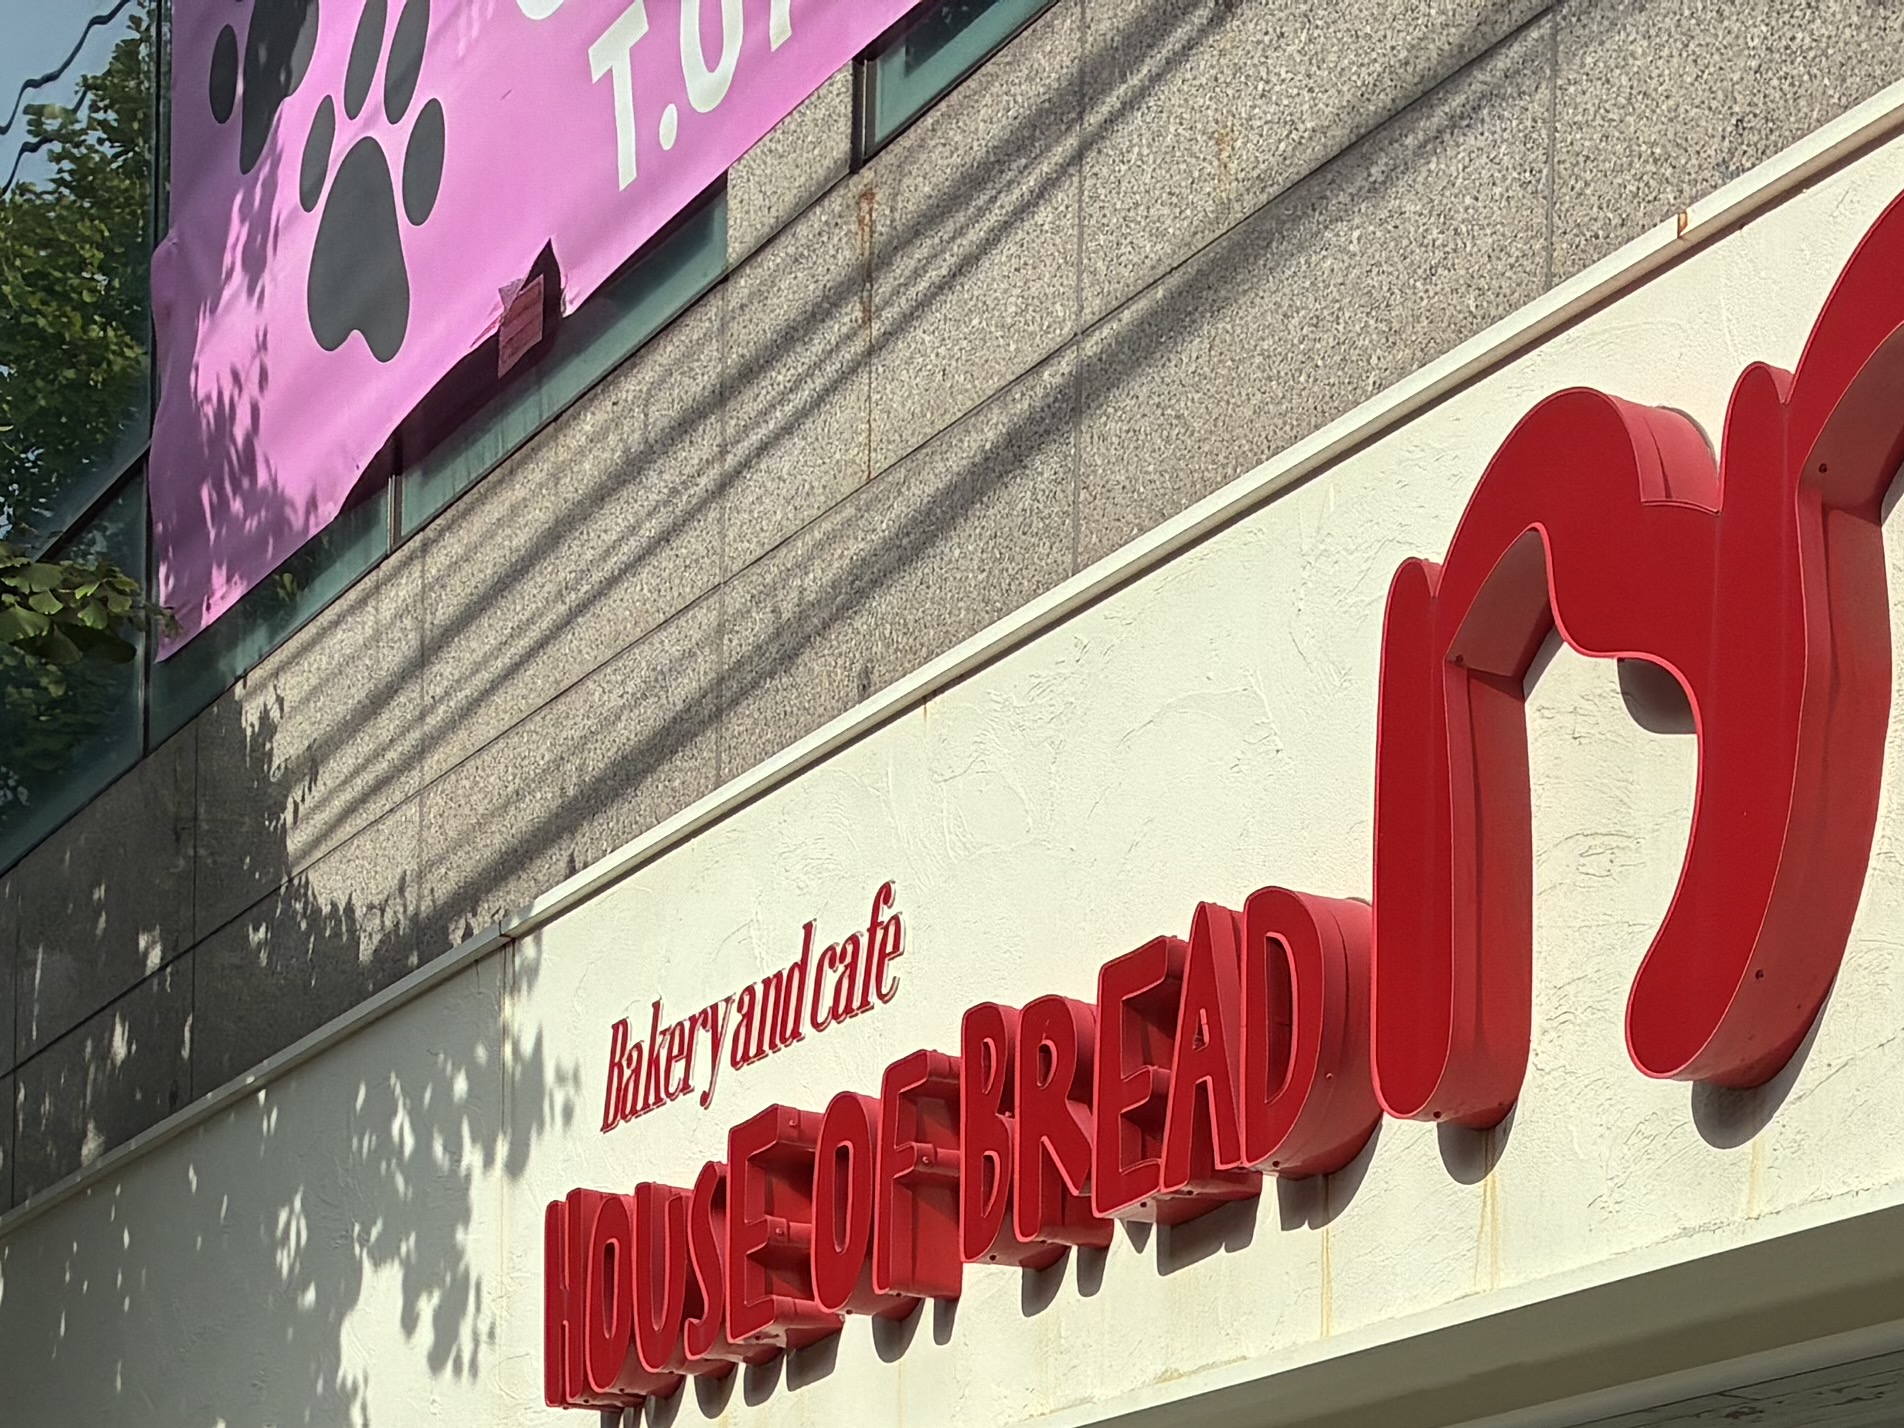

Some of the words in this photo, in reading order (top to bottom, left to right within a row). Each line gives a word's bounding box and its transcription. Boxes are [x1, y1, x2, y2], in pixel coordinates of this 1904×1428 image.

[544, 1104, 831, 1411] HOUSE
[811, 1050, 962, 1316] OF
[960, 885, 1379, 1266] BREAD
[600, 995, 736, 1133] Bakery
[730, 919, 817, 1070] and
